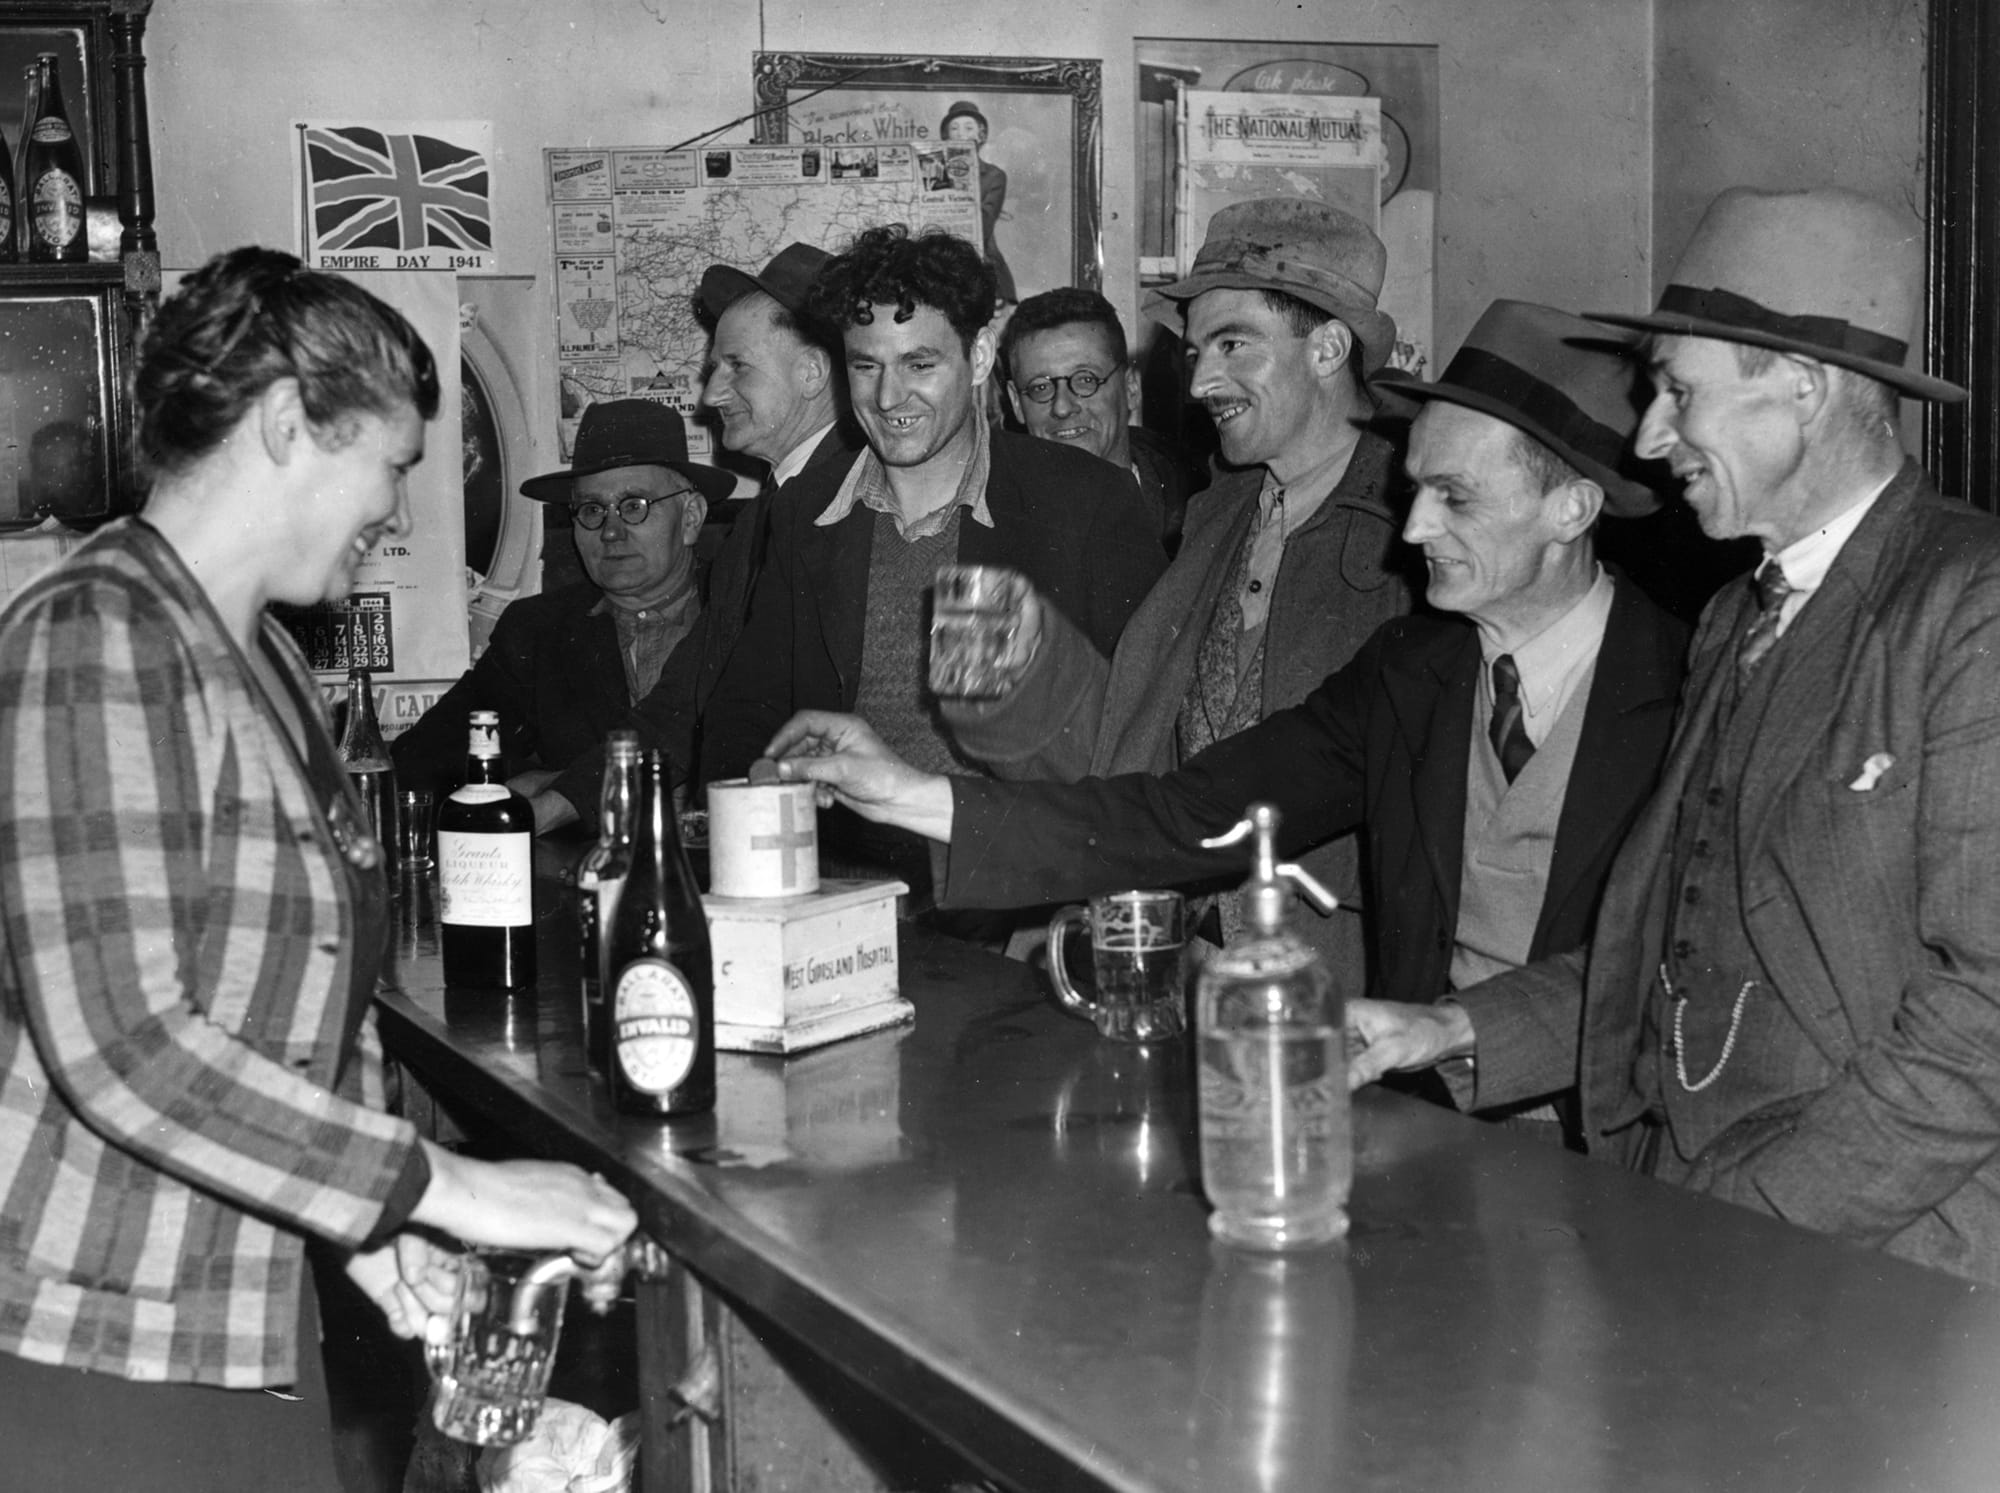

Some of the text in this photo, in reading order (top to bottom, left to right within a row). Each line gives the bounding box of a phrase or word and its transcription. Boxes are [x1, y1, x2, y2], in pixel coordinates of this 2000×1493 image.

[803, 123, 858, 144] Black
[873, 114, 929, 139] White
[1205, 113, 1362, 141] THE NATIONAL MUTUAL
[36, 174, 78, 195] BALLRAT
[36, 204, 80, 215] INVID
[320, 255, 482, 269] EMPIRE DAY 1941
[383, 546, 411, 556] LTD.
[355, 613, 385, 625] 1 2
[335, 624, 346, 636] 7
[353, 624, 364, 636] 8
[374, 623, 385, 635] 9
[335, 635, 348, 646] 14
[353, 634, 367, 647] 15
[372, 634, 387, 646] 16
[335, 646, 348, 657] 21
[353, 646, 369, 657] 22
[372, 645, 389, 656] 23
[314, 656, 389, 669] 27 28 29 30
[446, 859, 508, 869] LIQUEUR
[807, 956, 853, 984] GIPPSLAND
[856, 943, 894, 972] HOSPITAL
[619, 1017, 690, 1039] INVALID
